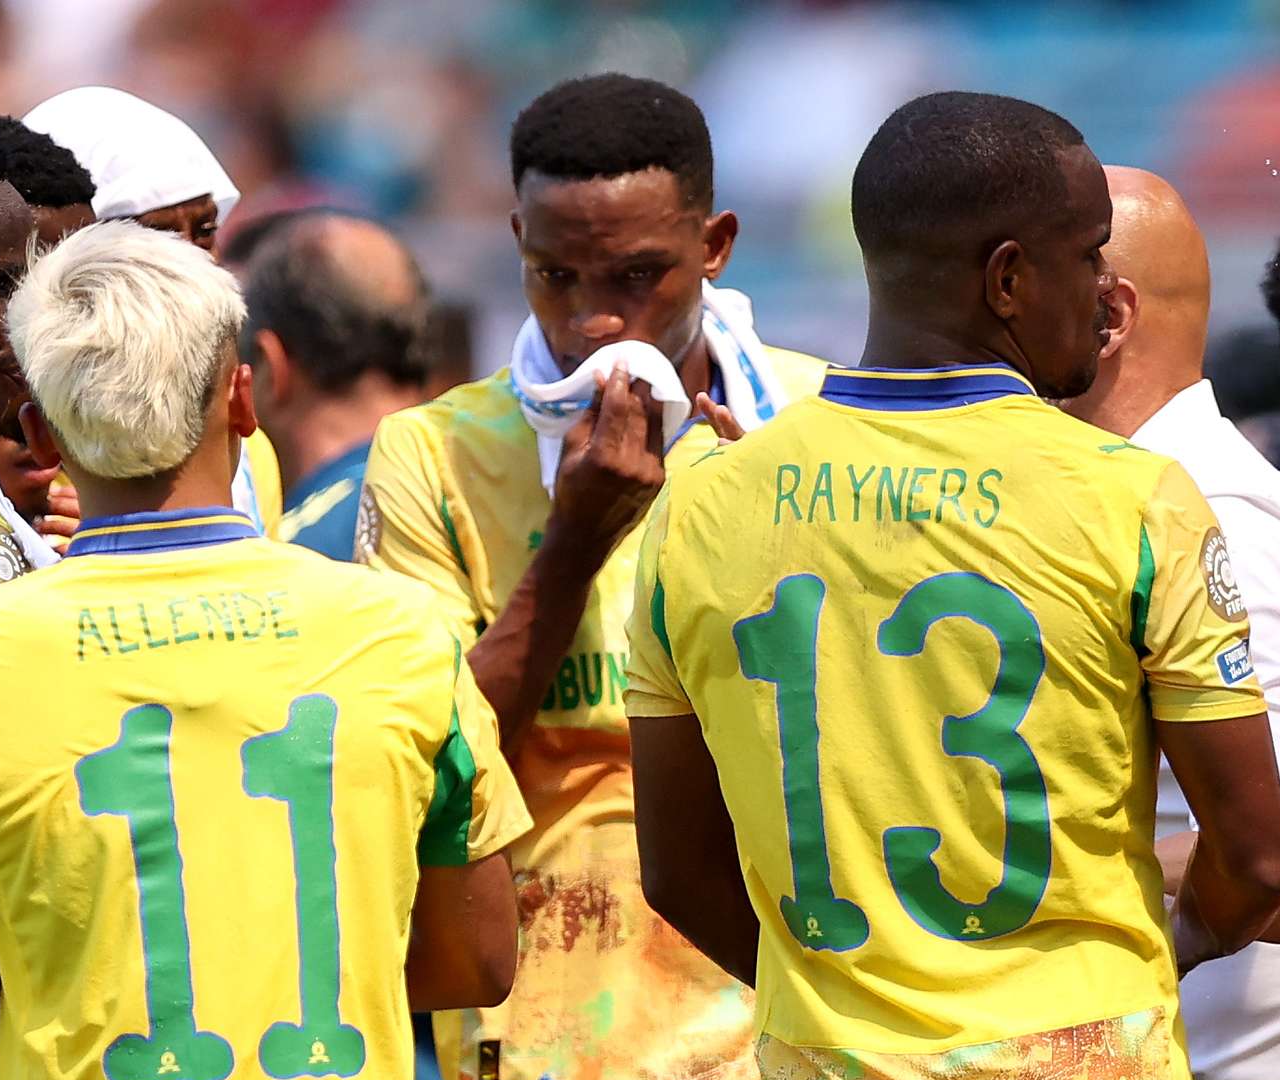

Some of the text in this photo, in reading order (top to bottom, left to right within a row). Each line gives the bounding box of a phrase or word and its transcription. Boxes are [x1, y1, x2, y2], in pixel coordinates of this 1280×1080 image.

[774, 462, 1004, 528] RAYNERS
[77, 591, 299, 661] ALLENDE
[732, 571, 1052, 952] 13
